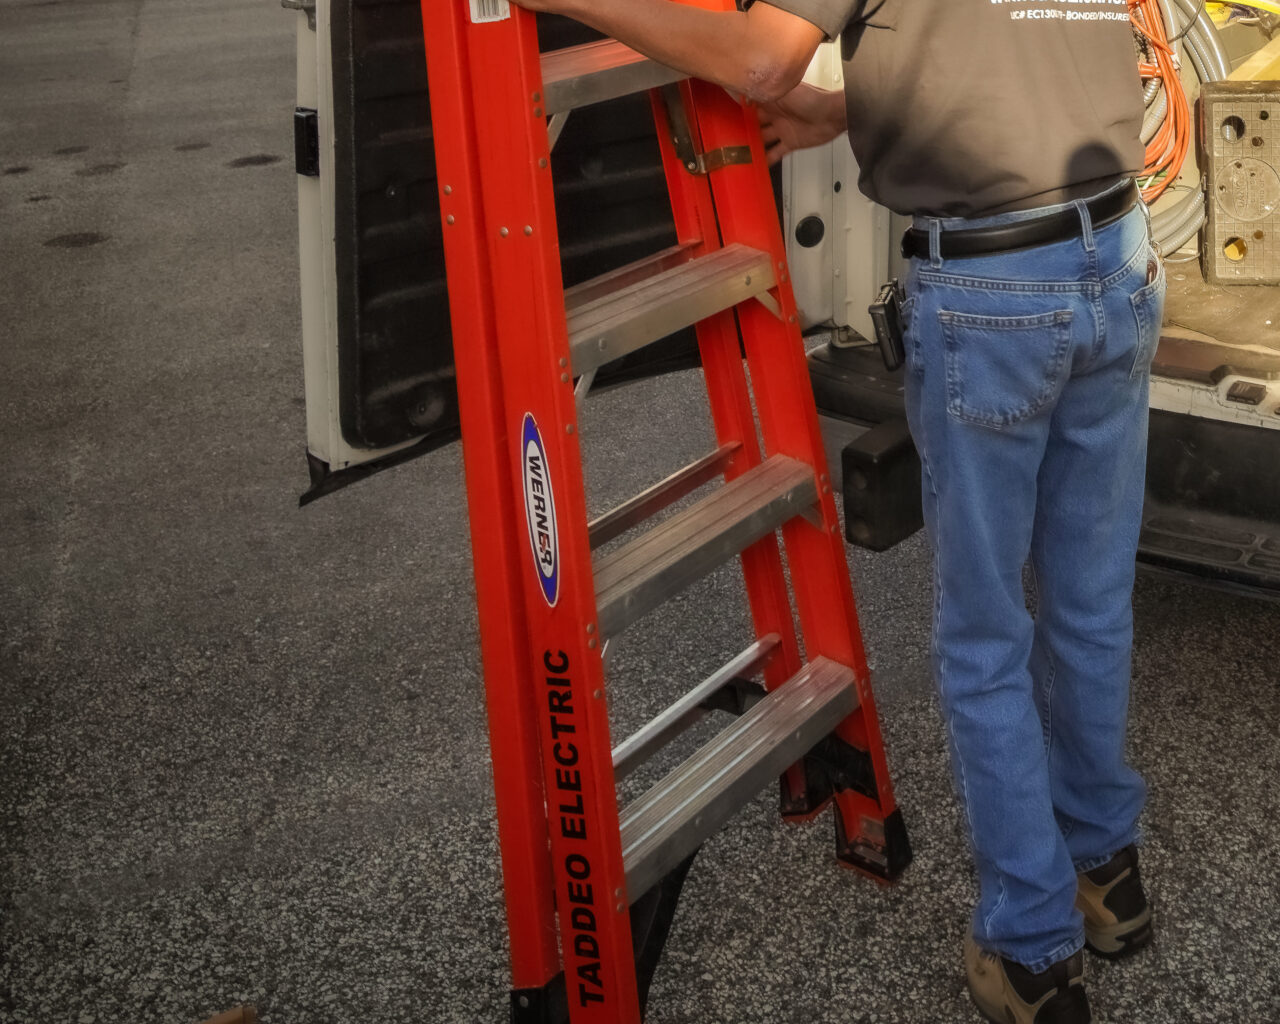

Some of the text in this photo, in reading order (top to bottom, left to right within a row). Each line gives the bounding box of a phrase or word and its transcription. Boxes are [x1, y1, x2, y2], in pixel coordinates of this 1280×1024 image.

[528, 455, 553, 566] WERNER
[543, 648, 605, 1008] TADDEO ELECTRIC
